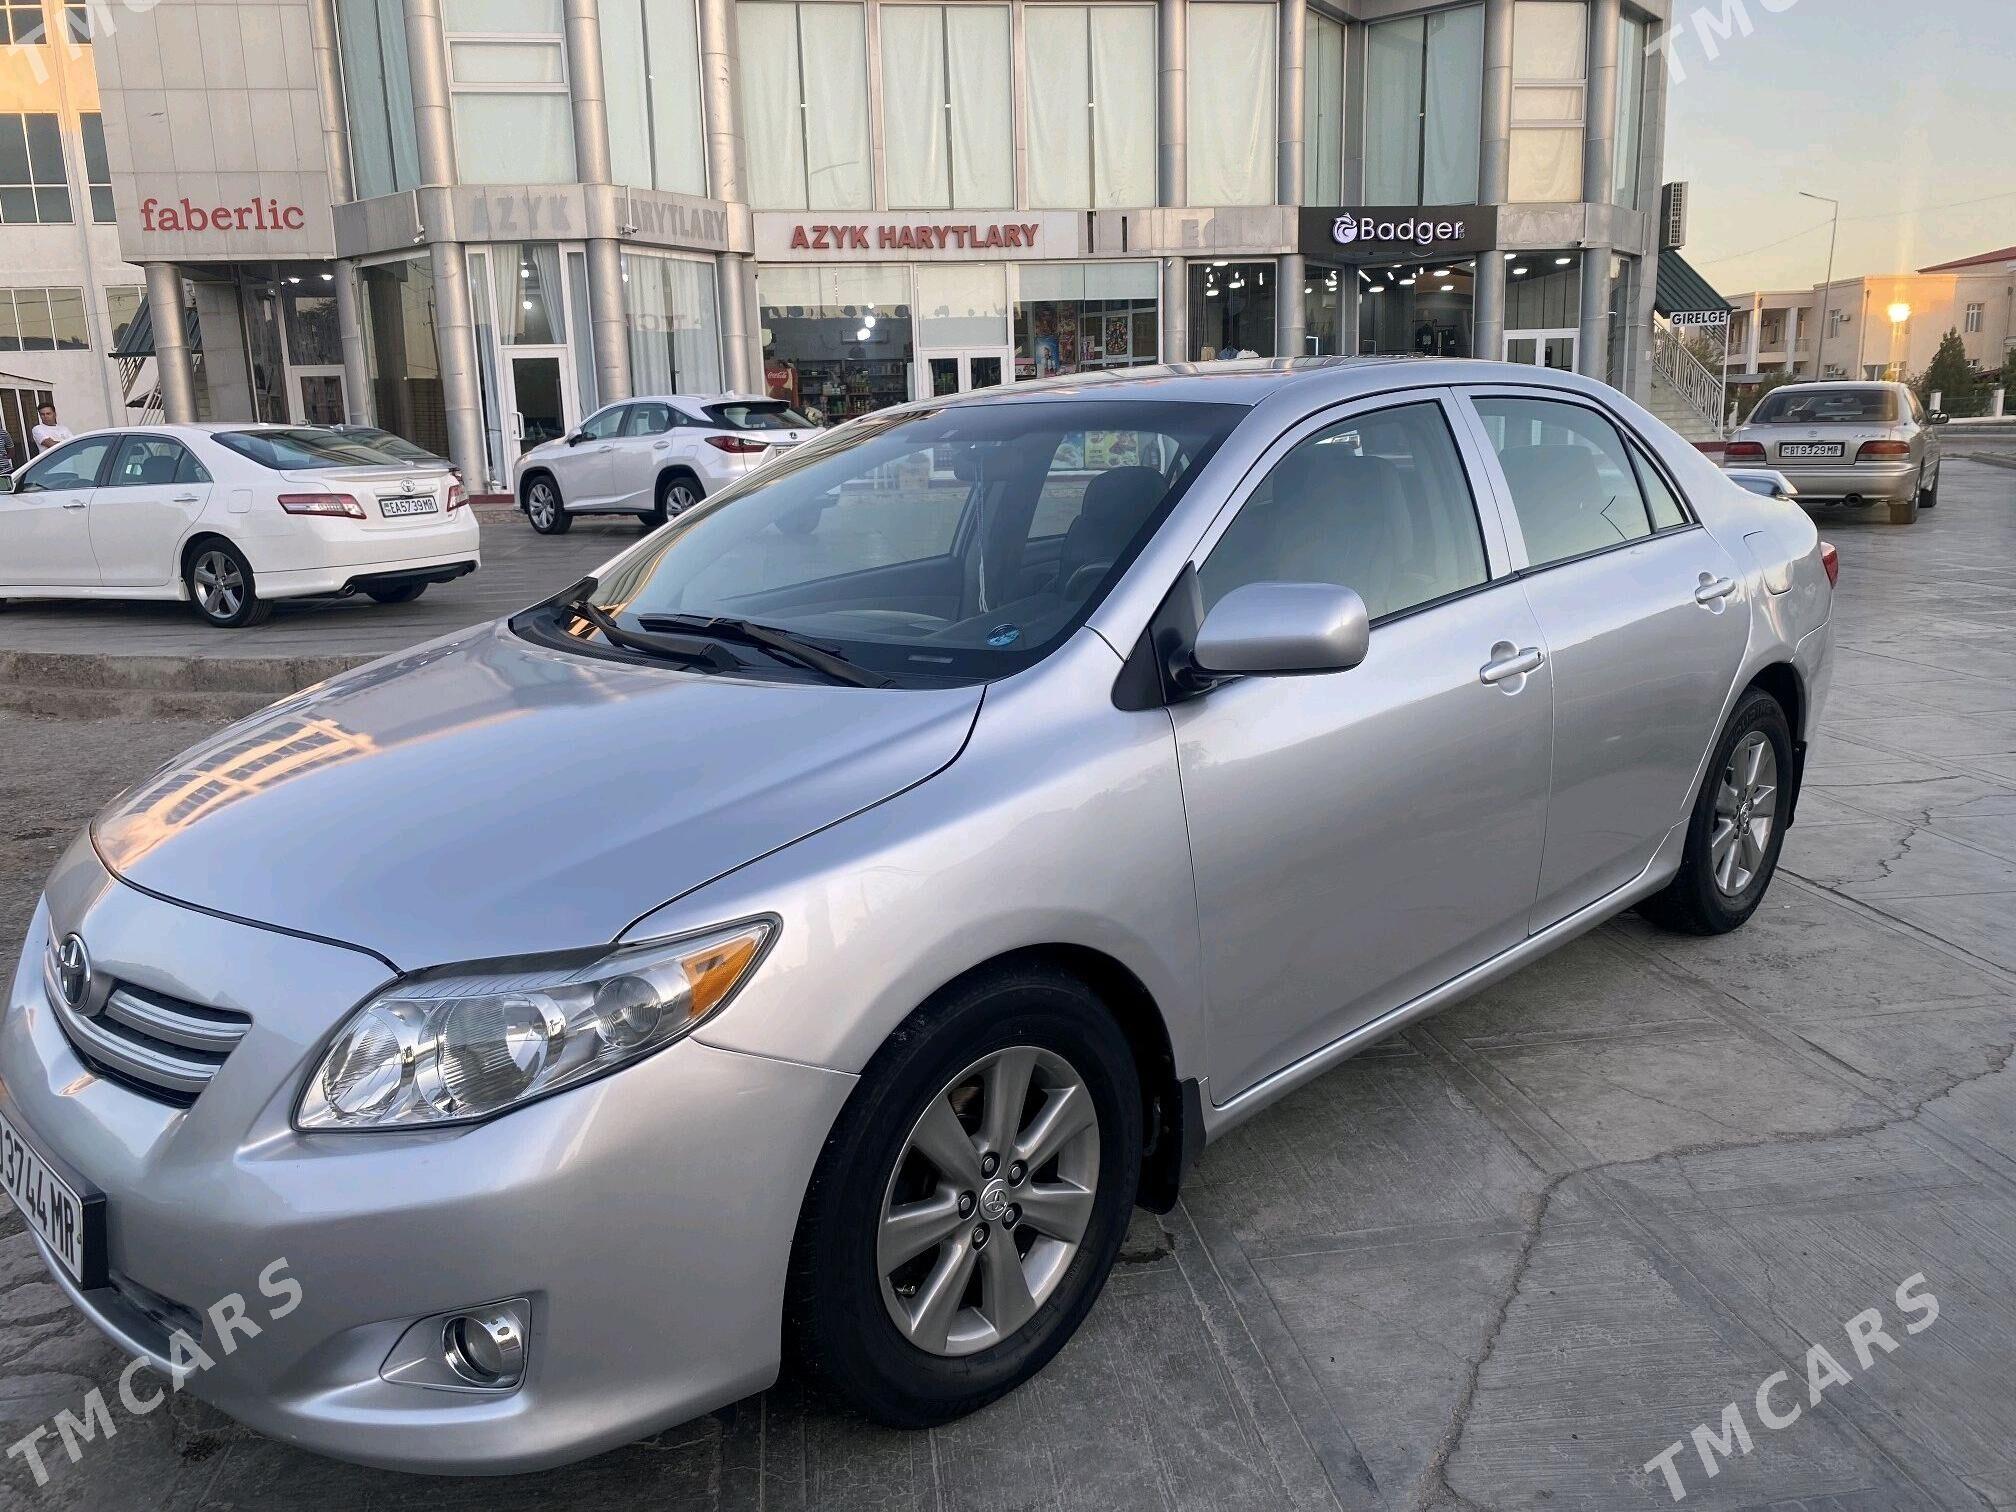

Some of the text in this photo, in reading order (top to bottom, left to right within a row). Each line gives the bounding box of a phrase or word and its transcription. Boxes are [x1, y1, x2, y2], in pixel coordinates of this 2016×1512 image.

[140, 197, 305, 232] faberlic
[790, 223, 1040, 250] AZYK HARYTLARY
[1360, 217, 1464, 245] Badger
[1672, 311, 1726, 325] GIRELGE
